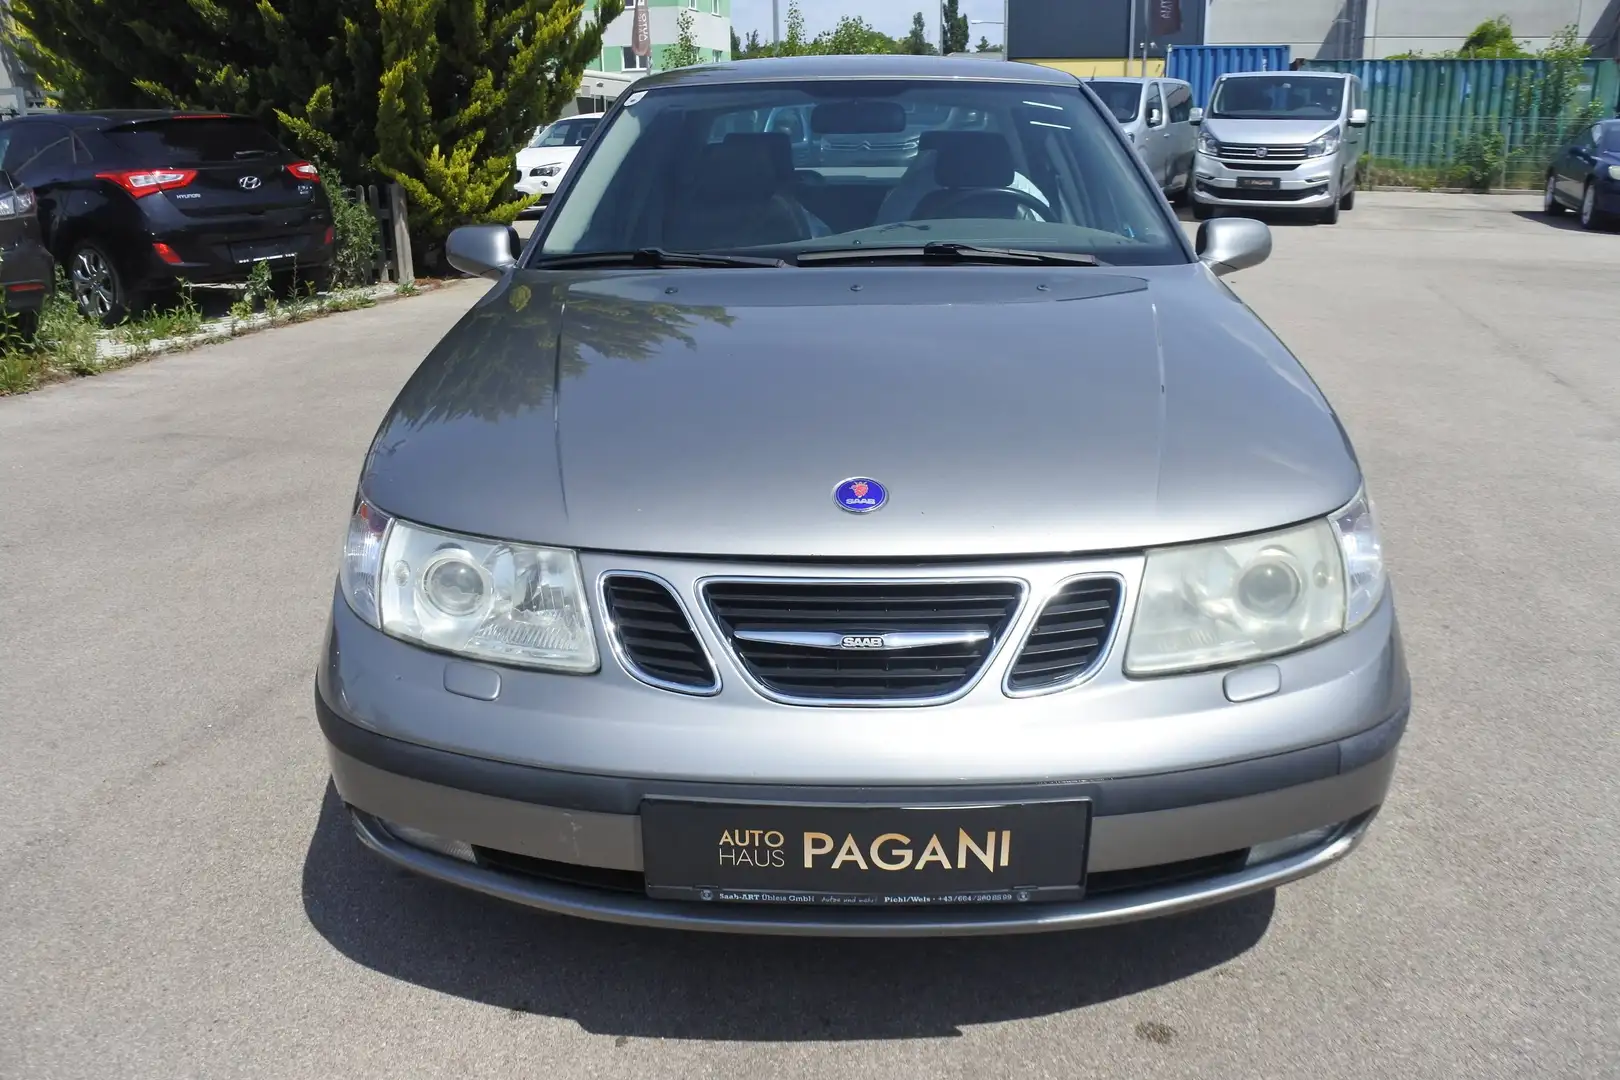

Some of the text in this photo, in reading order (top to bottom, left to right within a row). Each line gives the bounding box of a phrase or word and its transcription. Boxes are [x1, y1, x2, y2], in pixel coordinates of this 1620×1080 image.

[843, 637, 882, 648] SAAB
[719, 829, 785, 847] AUTO
[719, 848, 785, 867] HAUS
[803, 827, 1011, 873] PAGANI
[719, 893, 760, 901] Saab-ART
